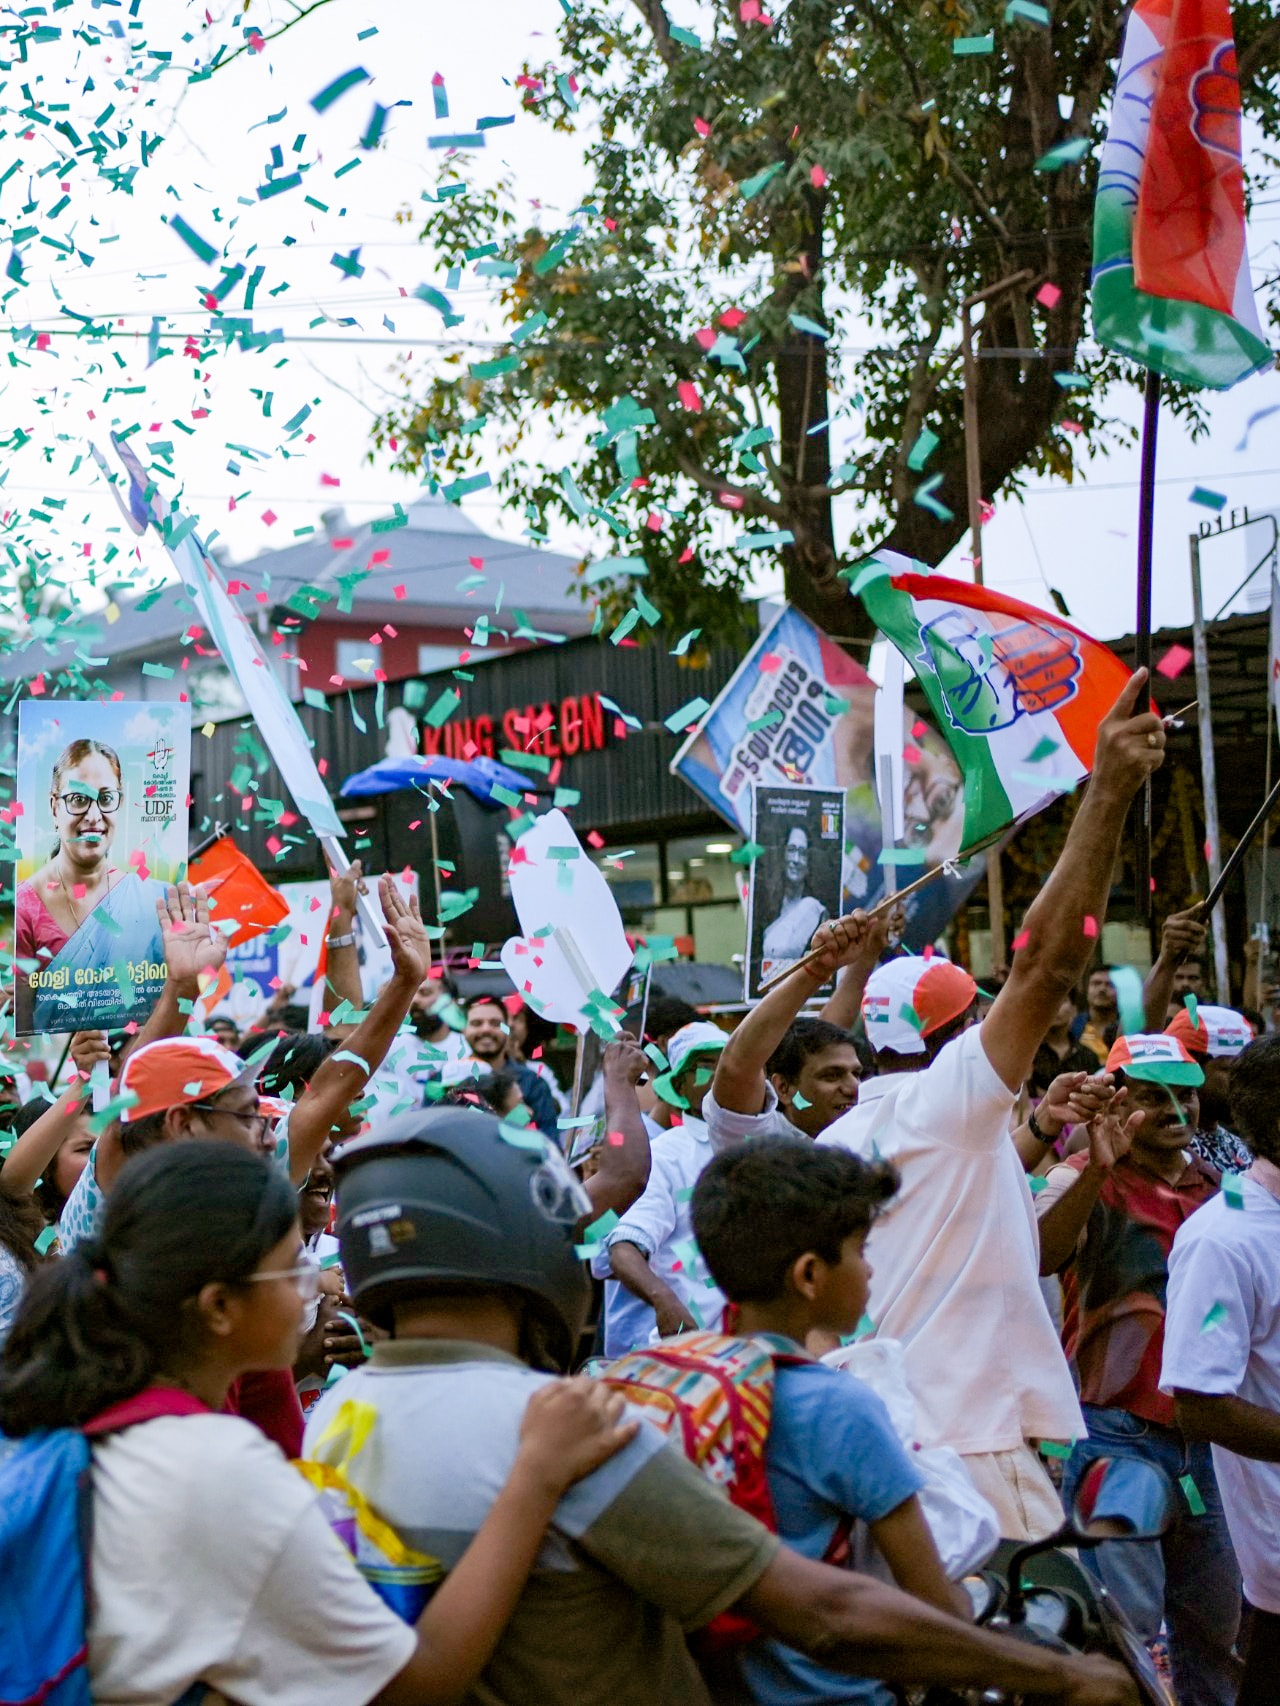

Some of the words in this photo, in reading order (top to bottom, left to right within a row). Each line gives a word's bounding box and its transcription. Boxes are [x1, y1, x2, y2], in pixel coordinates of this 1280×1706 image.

[424, 714, 493, 763] KING
[145, 800, 174, 815] UDF
[28, 966, 70, 990] ഗേളി
